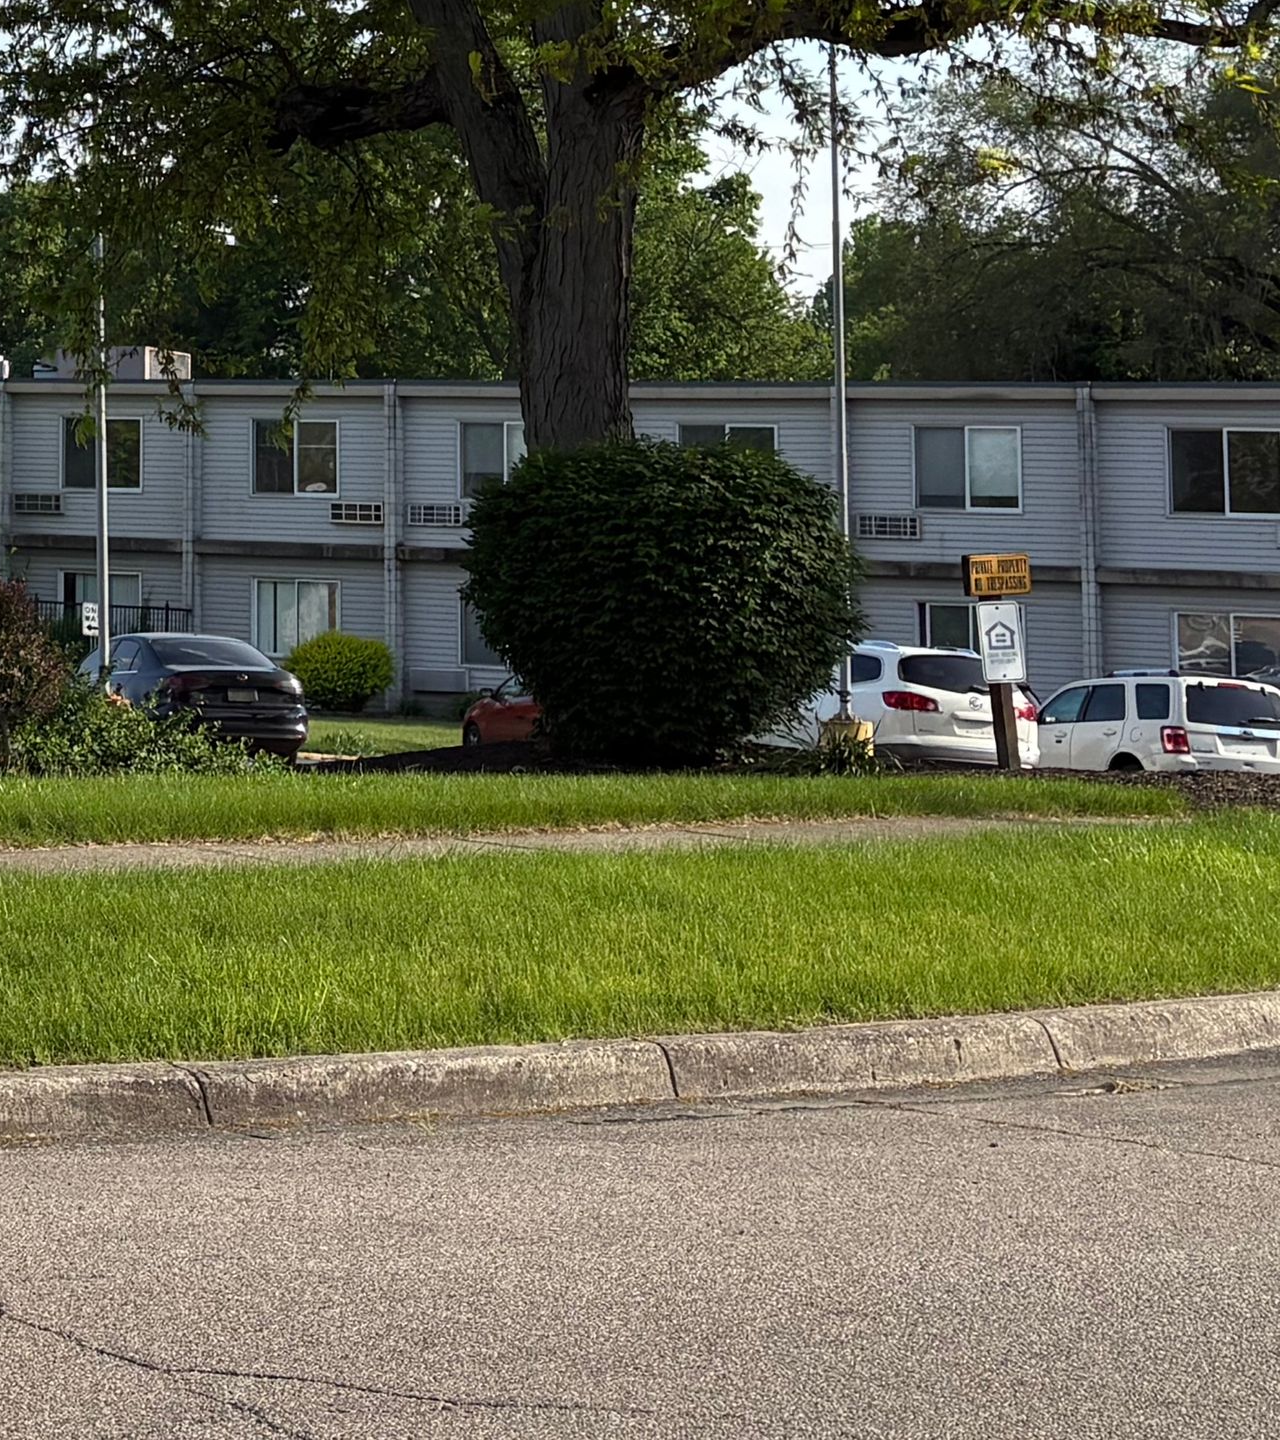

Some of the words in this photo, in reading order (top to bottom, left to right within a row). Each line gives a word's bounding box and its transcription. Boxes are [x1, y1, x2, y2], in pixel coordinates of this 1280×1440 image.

[970, 559, 993, 575] PRIVATE
[997, 559, 1027, 574] PROPERTY
[974, 576, 983, 592] NO
[986, 576, 1027, 591] TRESPASSING
[84, 606, 97, 614] ON
